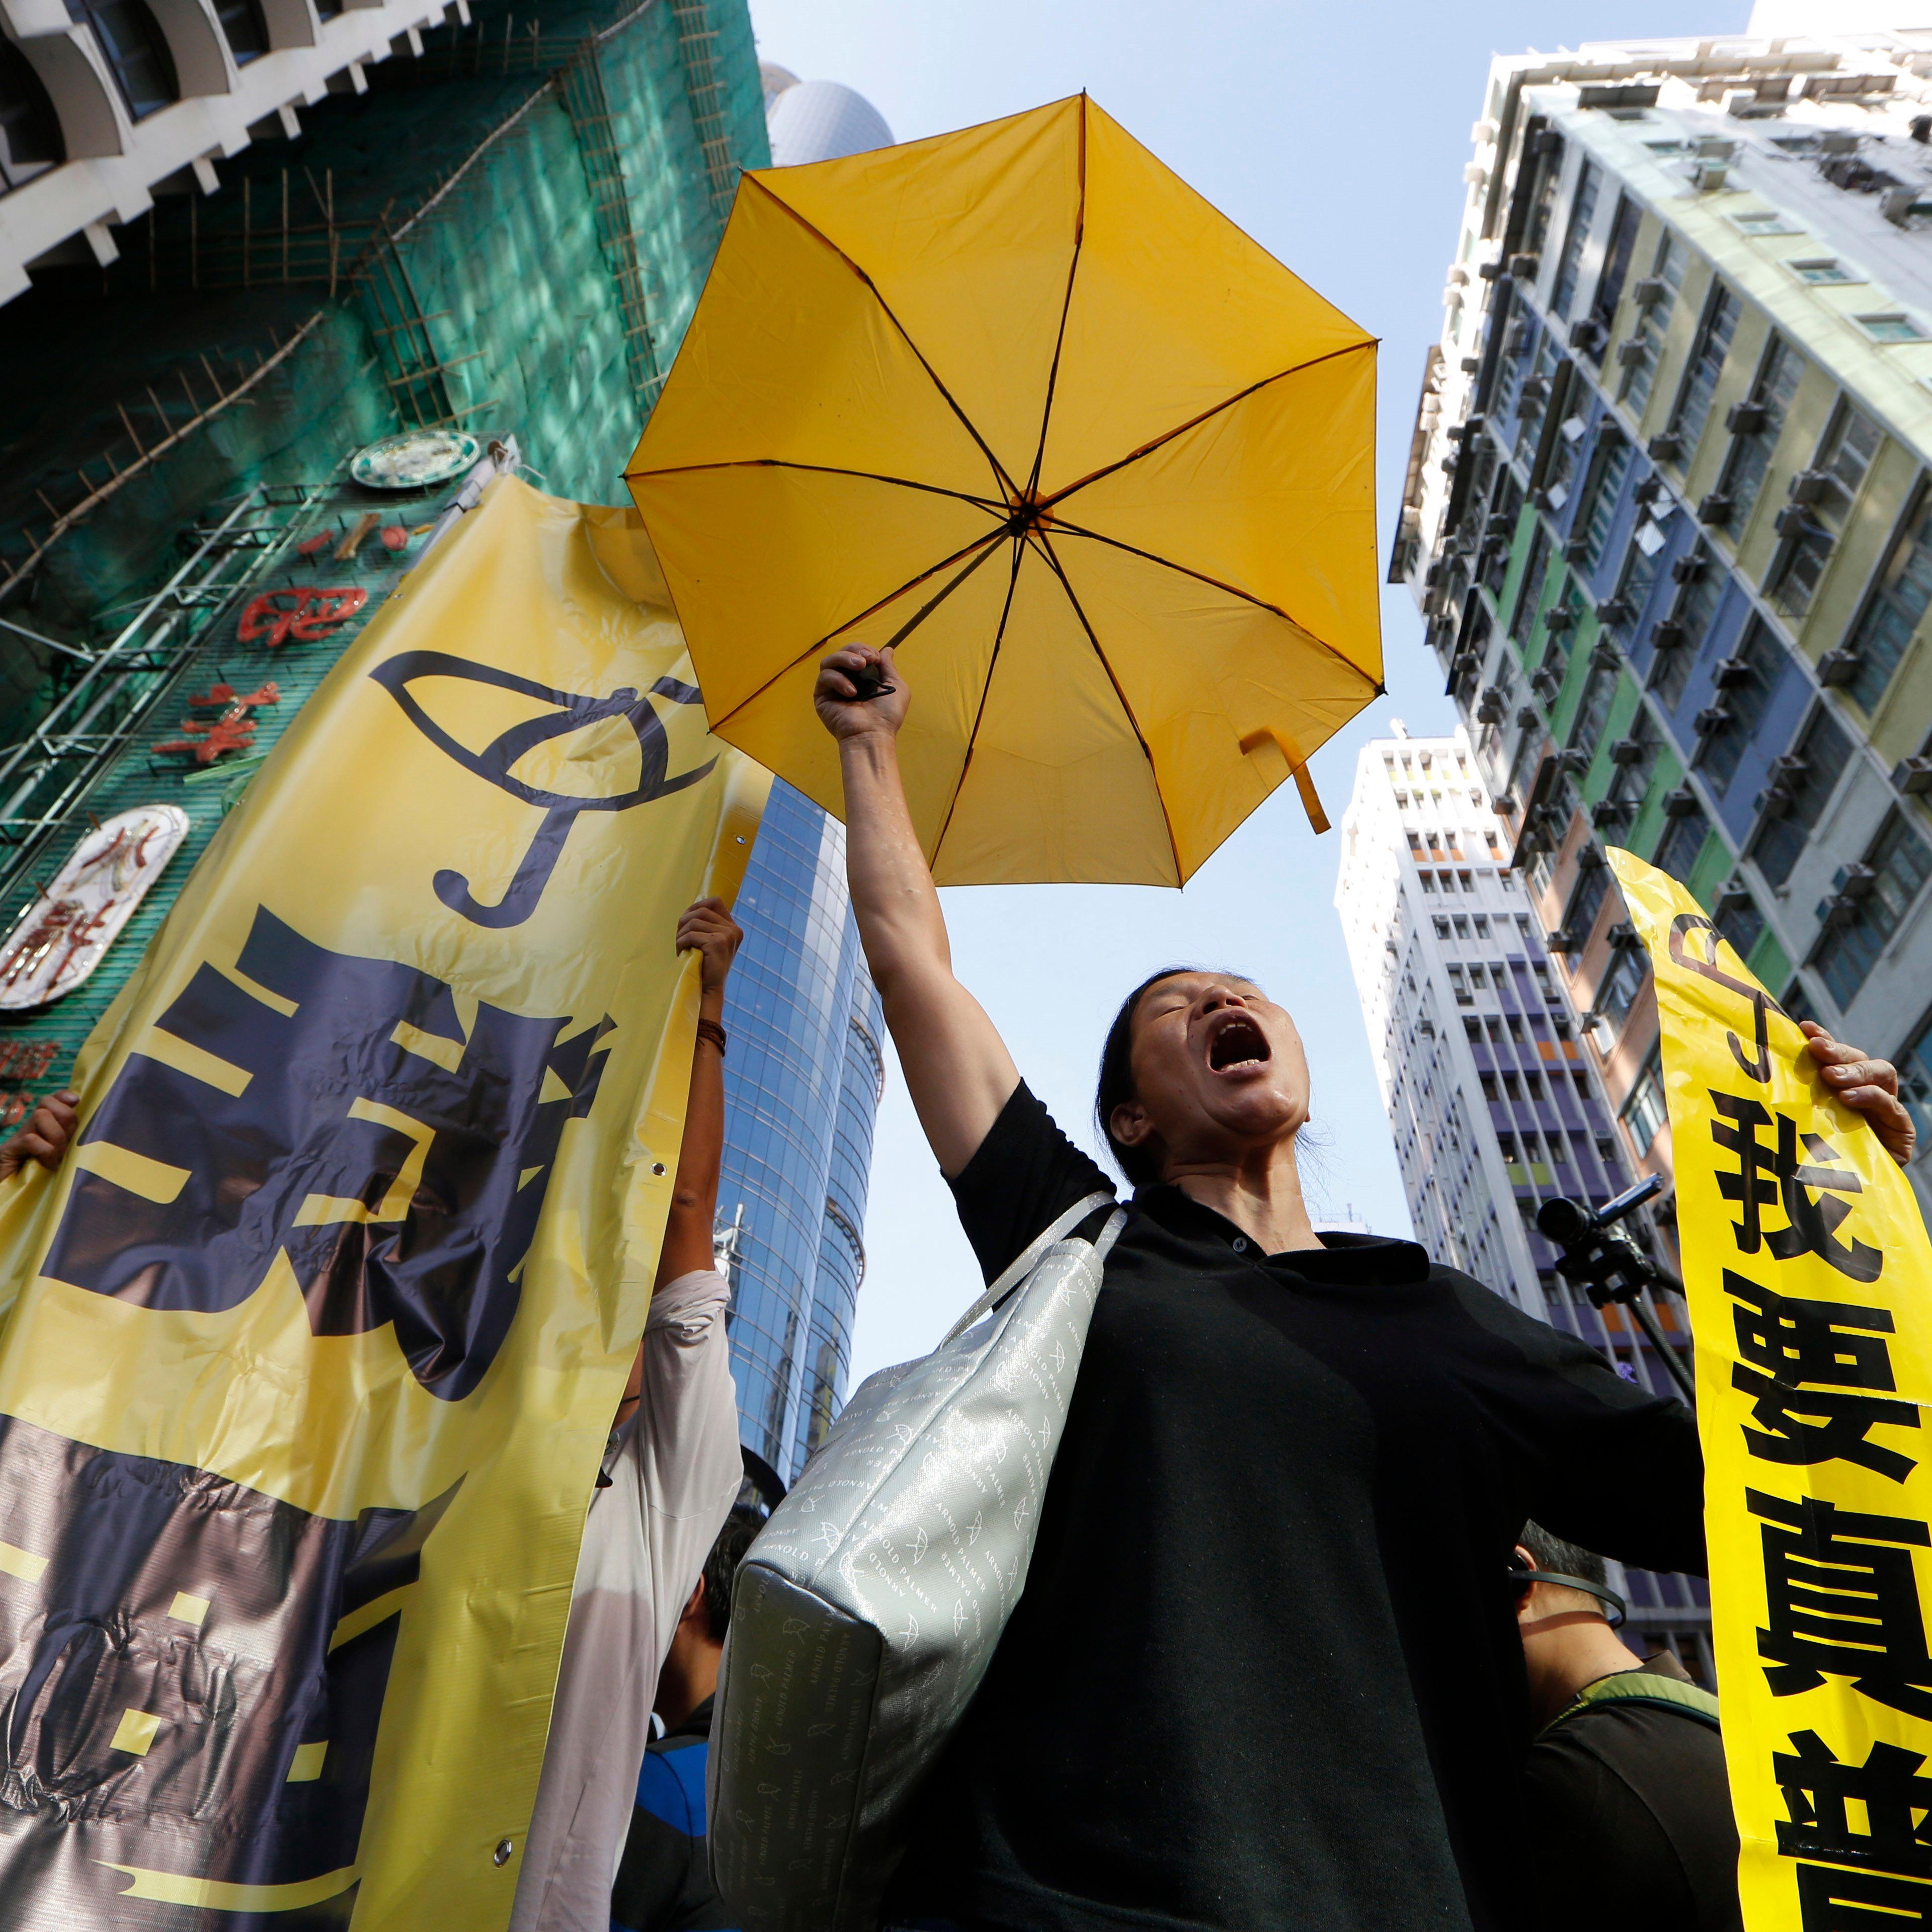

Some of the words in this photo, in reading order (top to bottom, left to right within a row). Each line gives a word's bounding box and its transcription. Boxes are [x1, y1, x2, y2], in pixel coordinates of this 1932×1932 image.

[1021, 1361, 1050, 1400] ARNOLD
[1049, 1374, 1065, 1415] PALMER
[1006, 1409, 1036, 1448] ARNOLD
[985, 1464, 1006, 1508] PALMER
[935, 1503, 959, 1545] ARNOLD
[957, 1547, 986, 1593] PALMER
[869, 1553, 906, 1597] ARNOLD
[900, 1567, 938, 1614] PALMER
[941, 1551, 972, 1597] PALMER
[984, 1550, 1004, 1592] ARNOLD
[781, 1649, 796, 1689] PALMER
[810, 1645, 826, 1685] ARNOLD
